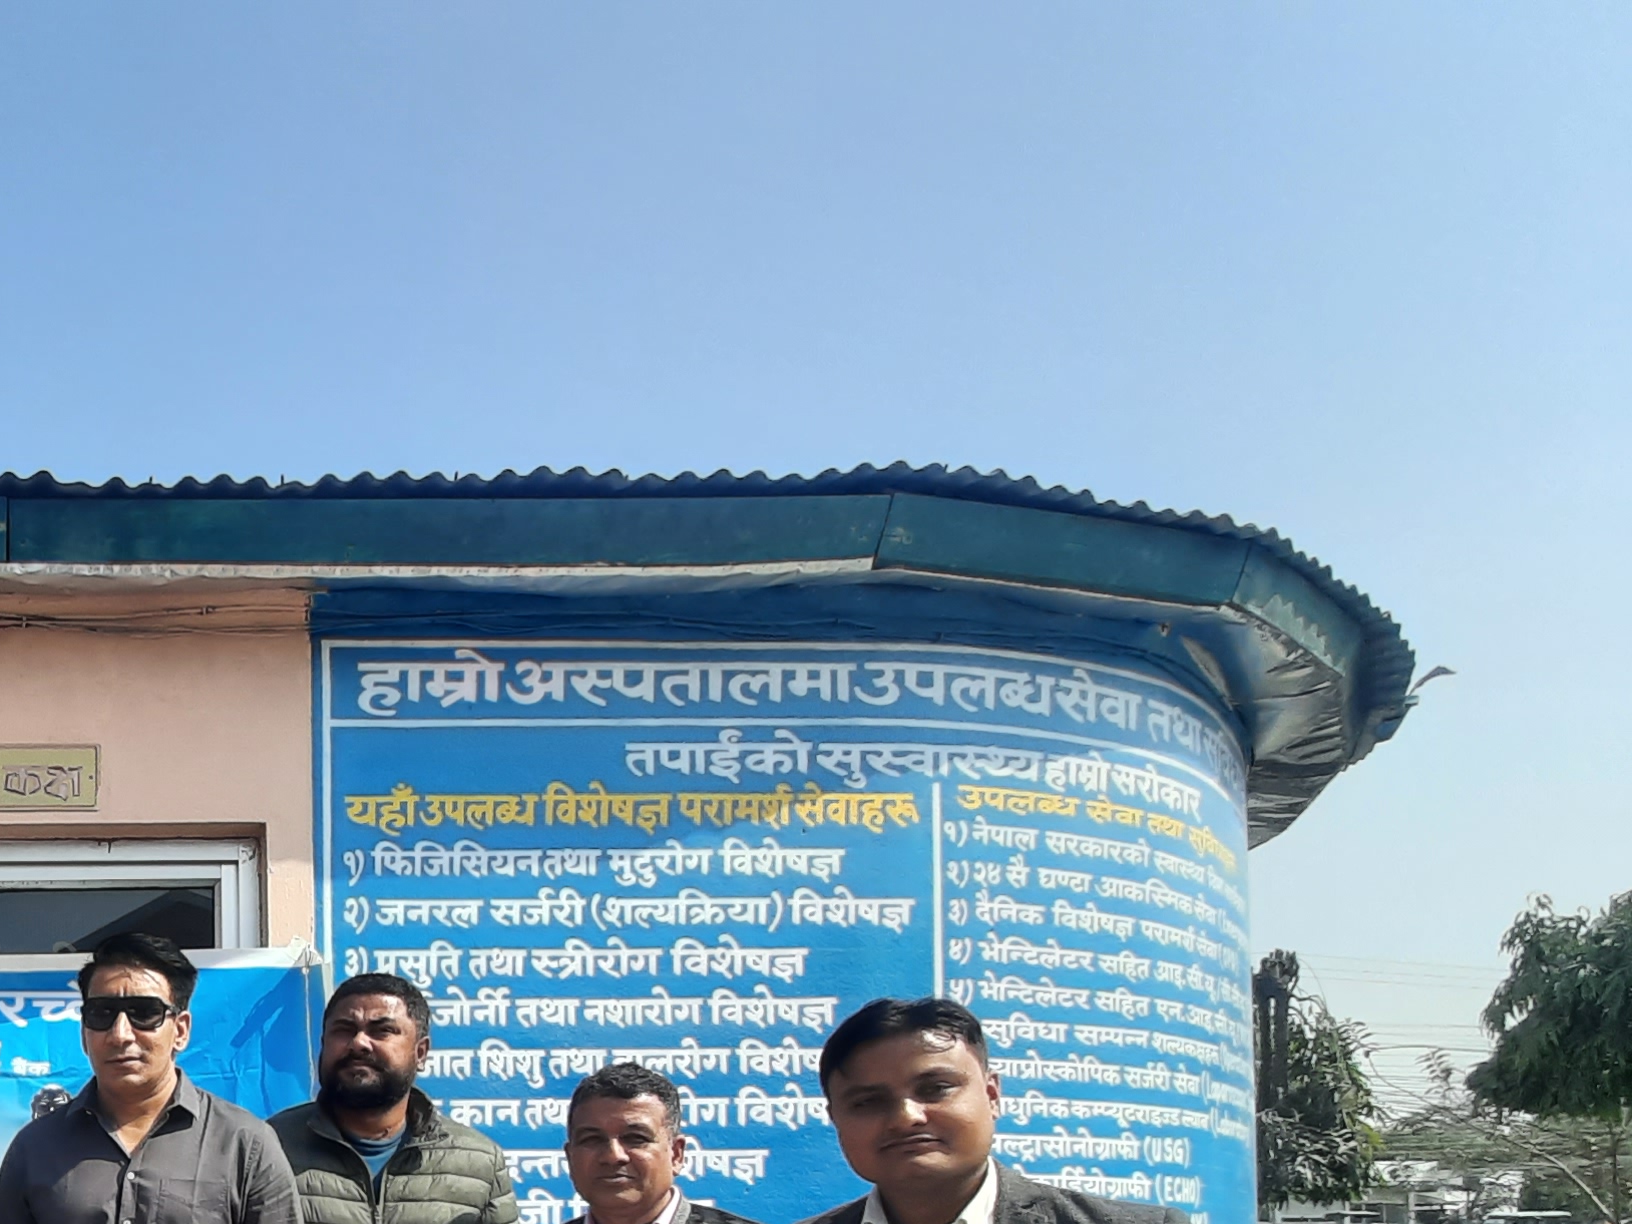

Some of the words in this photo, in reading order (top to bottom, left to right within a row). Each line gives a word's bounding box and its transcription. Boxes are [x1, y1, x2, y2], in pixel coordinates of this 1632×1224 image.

[358, 648, 505, 716] हाम्रो
[505, 660, 857, 707] अस्पतालमा
[854, 661, 1063, 718] उपलब्ध
[1056, 668, 1142, 732] सेवा
[1148, 699, 1202, 755] तथा
[344, 783, 419, 836] यहाँ
[419, 794, 538, 830] उपलब्ध
[542, 780, 672, 836] विशेषज्ञ
[676, 781, 794, 831] परामर्श
[795, 781, 920, 834] सेवाहरू
[956, 785, 1081, 816] उपलब्ध
[1085, 793, 1144, 827] सेवा
[1045, 749, 1111, 793] हाम्रो
[1111, 764, 1201, 824] सरोकार
[371, 839, 541, 879] फिजिसियन
[543, 848, 602, 880] तथा
[606, 838, 714, 888] मुटुरोग
[718, 837, 846, 884] विशेषज्ञ
[971, 815, 1039, 851] नेपाल
[1044, 830, 1151, 868] सरकारको
[375, 899, 483, 929] जनरल
[489, 886, 586, 928] सर्जरी
[786, 885, 916, 934] विशेषज्ञ
[974, 888, 1046, 926] दैनिक
[468, 948, 529, 980] तथा
[530, 936, 662, 980] स्त्रीरोग
[669, 933, 809, 983] विशेषज्ञ
[1097, 951, 1152, 983] सहित
[515, 998, 579, 1029] तथा
[584, 986, 704, 1029] नशारोग
[706, 984, 838, 1034] विशेषज्ञ
[1093, 987, 1151, 1021] सहित
[981, 1012, 1069, 1049] सुविधा
[479, 1038, 544, 1089] शिशु
[549, 1047, 607, 1080] तथा
[734, 1035, 822, 1077] विशेष
[449, 1099, 521, 1127] कान
[734, 1083, 830, 1130] विशेष
